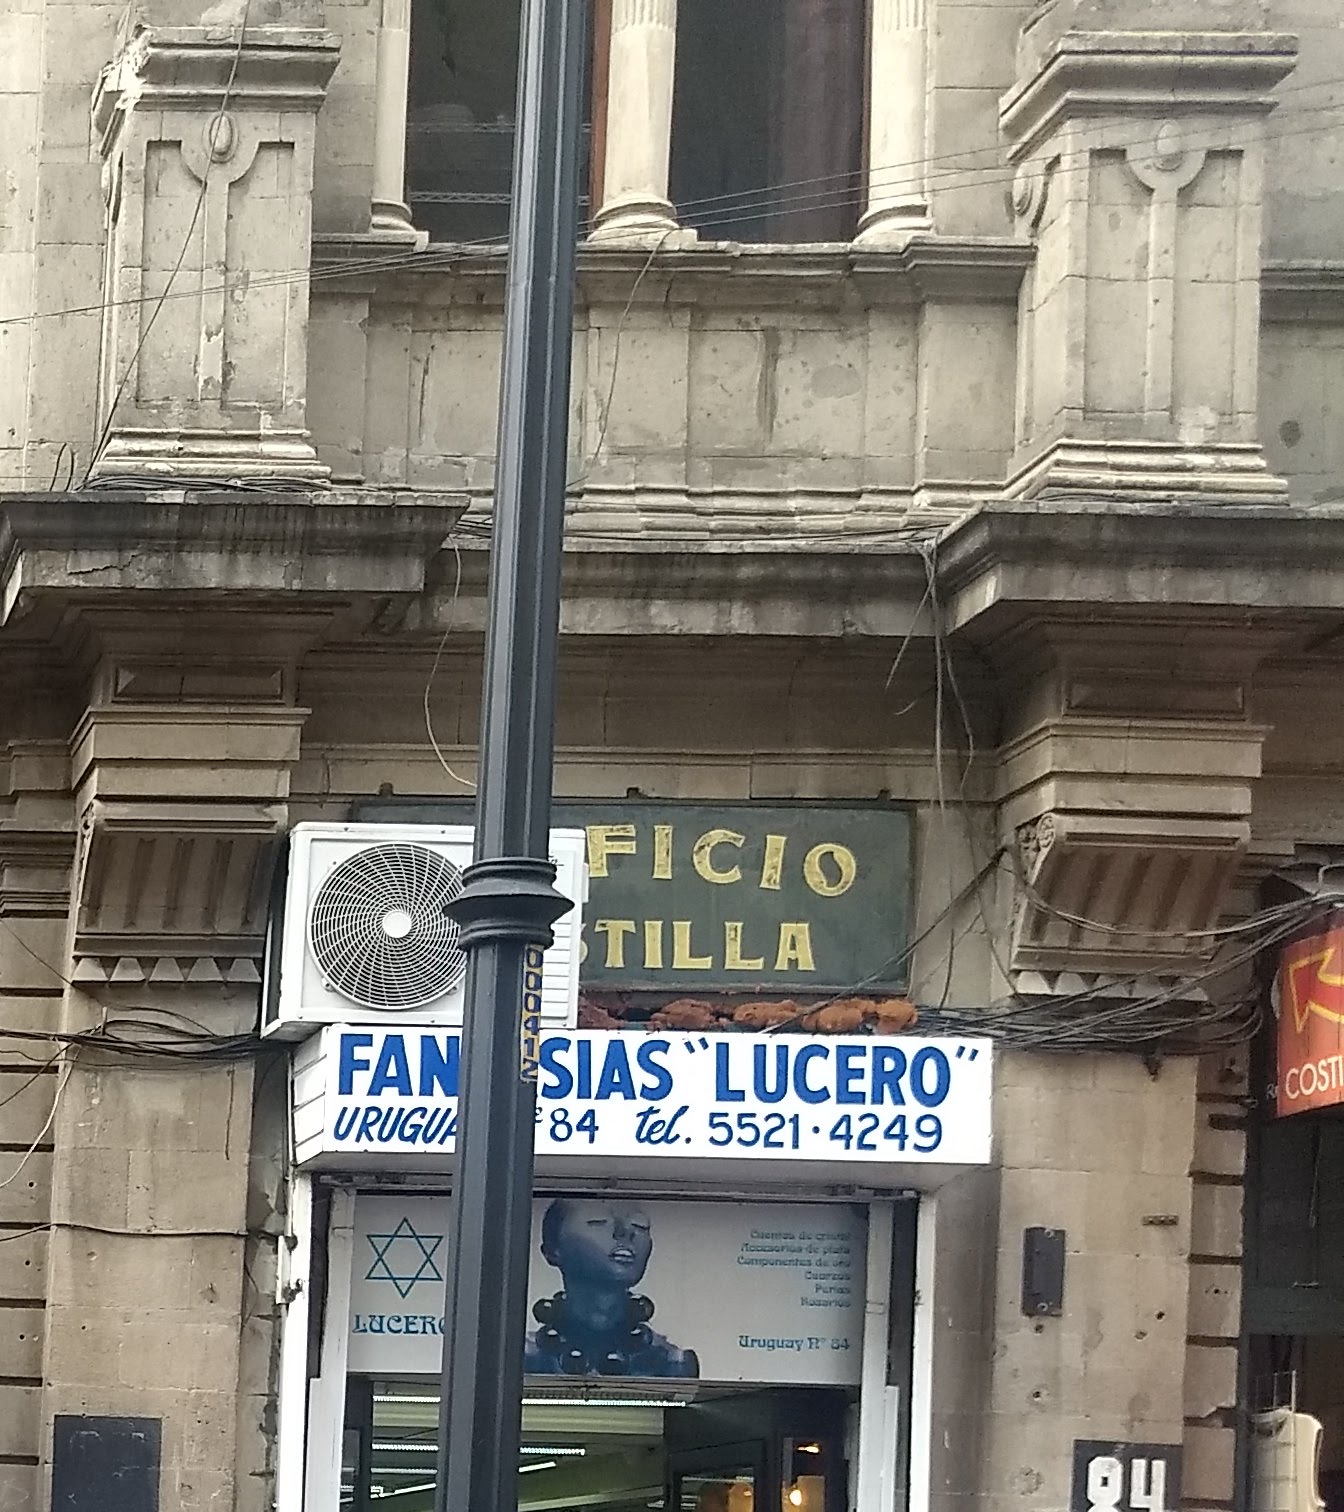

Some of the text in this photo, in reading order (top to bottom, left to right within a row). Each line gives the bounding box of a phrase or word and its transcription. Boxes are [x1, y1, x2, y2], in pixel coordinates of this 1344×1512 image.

[585, 824, 857, 897] FICIO
[580, 919, 816, 971] TILLA
[338, 1033, 674, 1101] FANSIAS
[333, 1106, 458, 1145] URUGUA
[550, 1108, 600, 1144] 84
[635, 1105, 692, 1145] tel.
[739, 1335, 804, 1352] Uruguay
[831, 1338, 850, 1350] 84
